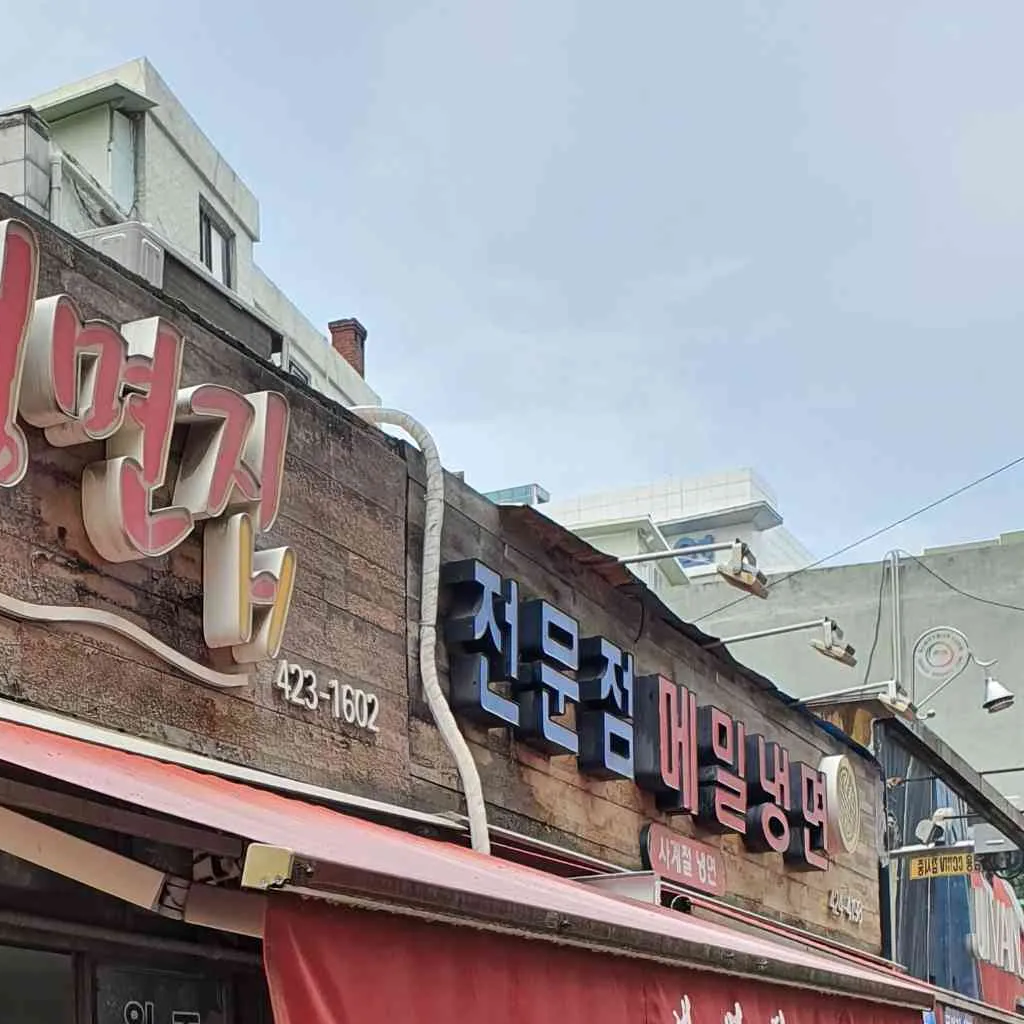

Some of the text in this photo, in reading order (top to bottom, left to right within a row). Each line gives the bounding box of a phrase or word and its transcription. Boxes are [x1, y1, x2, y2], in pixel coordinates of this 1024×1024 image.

[275, 658, 382, 736] 423-1602
[472, 557, 830, 872] 전문점 메밀냉면
